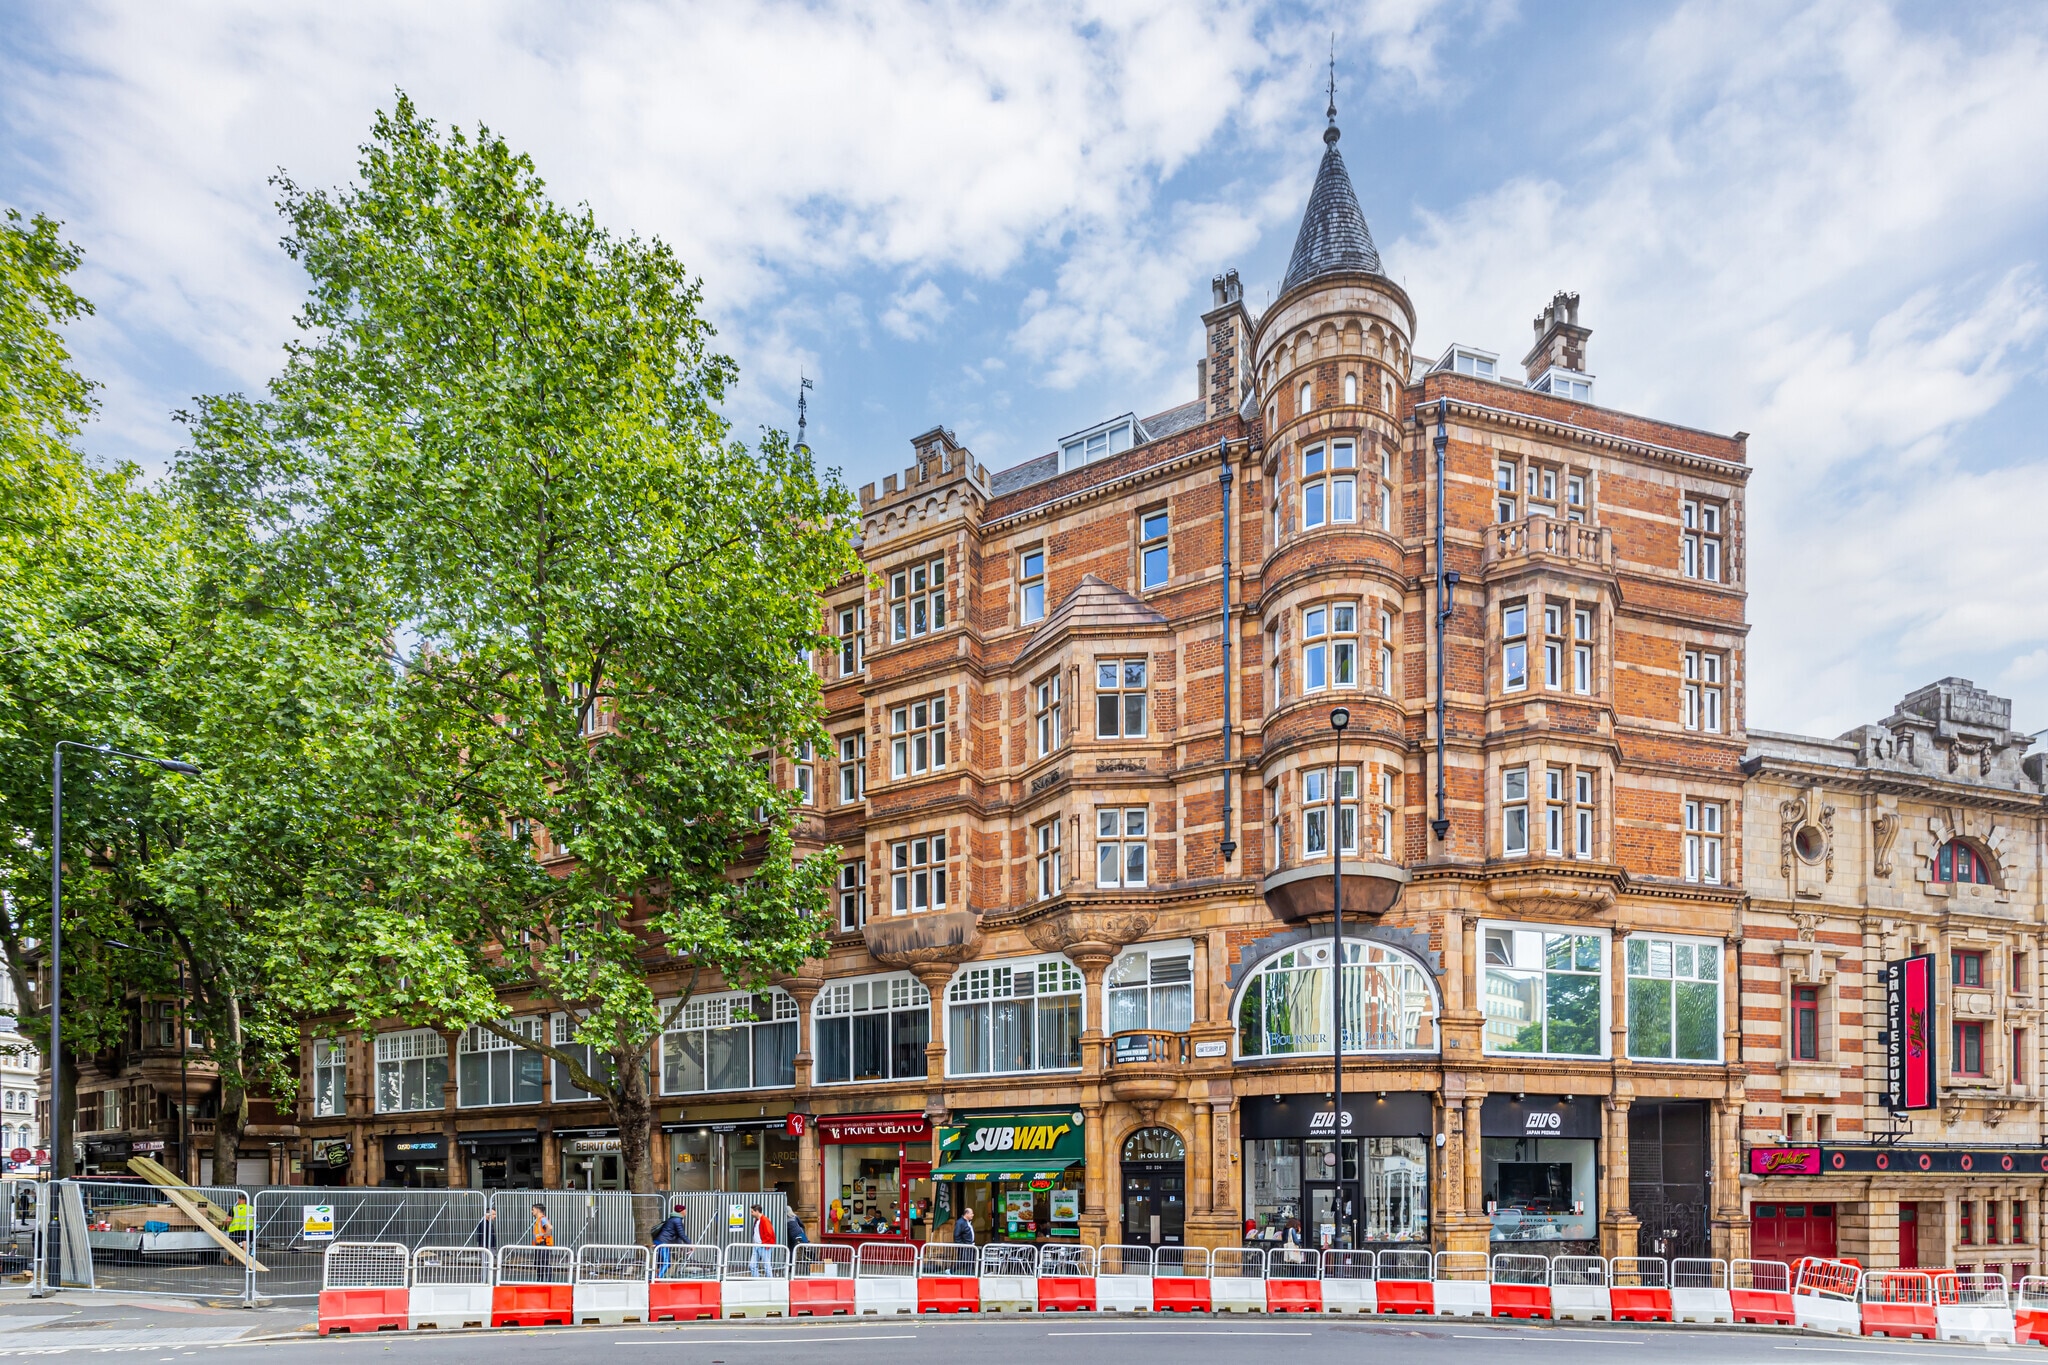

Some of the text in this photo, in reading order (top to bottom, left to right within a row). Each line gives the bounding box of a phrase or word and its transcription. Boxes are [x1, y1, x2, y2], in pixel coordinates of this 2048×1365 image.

[1269, 1031, 1327, 1046] BOURNER
[1889, 966, 1899, 1105] SHAFTESBURY
[1526, 1113, 1561, 1128] HIS
[878, 1125, 923, 1134] GELATO
[942, 1132, 961, 1147] SUBWAY
[968, 1123, 1071, 1152] SUBWAY
[1125, 1130, 1185, 1157] SOVEREIGN
[575, 1141, 621, 1152] BEIRUT GAR
[677, 1153, 707, 1163] BEIRUT
[1766, 1151, 1810, 1170] Juliet
[1033, 1172, 1059, 1180] SUBWAY
